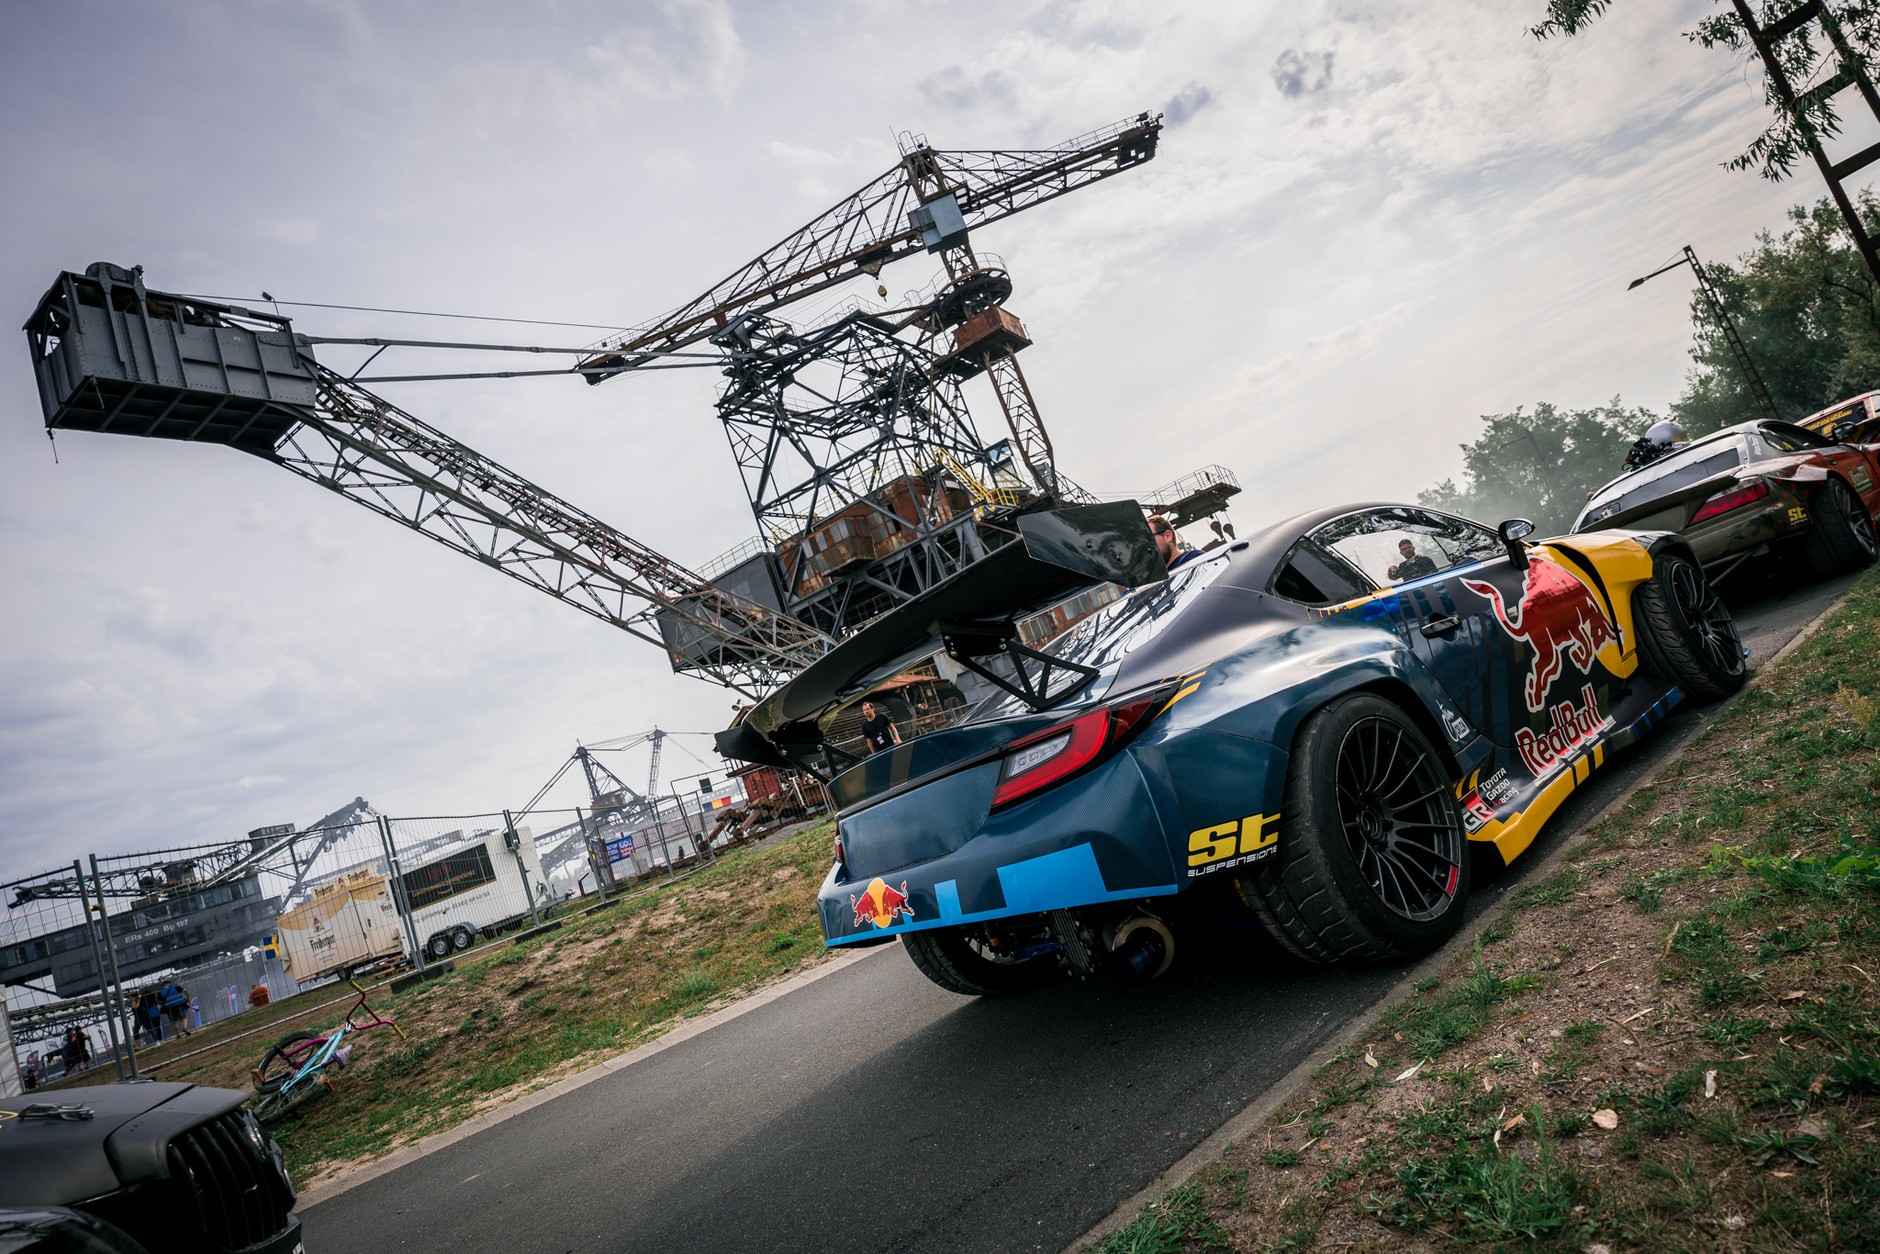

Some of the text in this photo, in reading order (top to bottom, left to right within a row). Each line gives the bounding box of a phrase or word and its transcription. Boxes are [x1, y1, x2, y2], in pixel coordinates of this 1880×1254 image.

[1479, 767, 1507, 792] TOYOTA
[1486, 778, 1511, 801] GAZOO
[1462, 802, 1494, 830] GR
[144, 928, 159, 937] 400
[176, 918, 189, 928] 197
[309, 934, 336, 953] Freiberger
